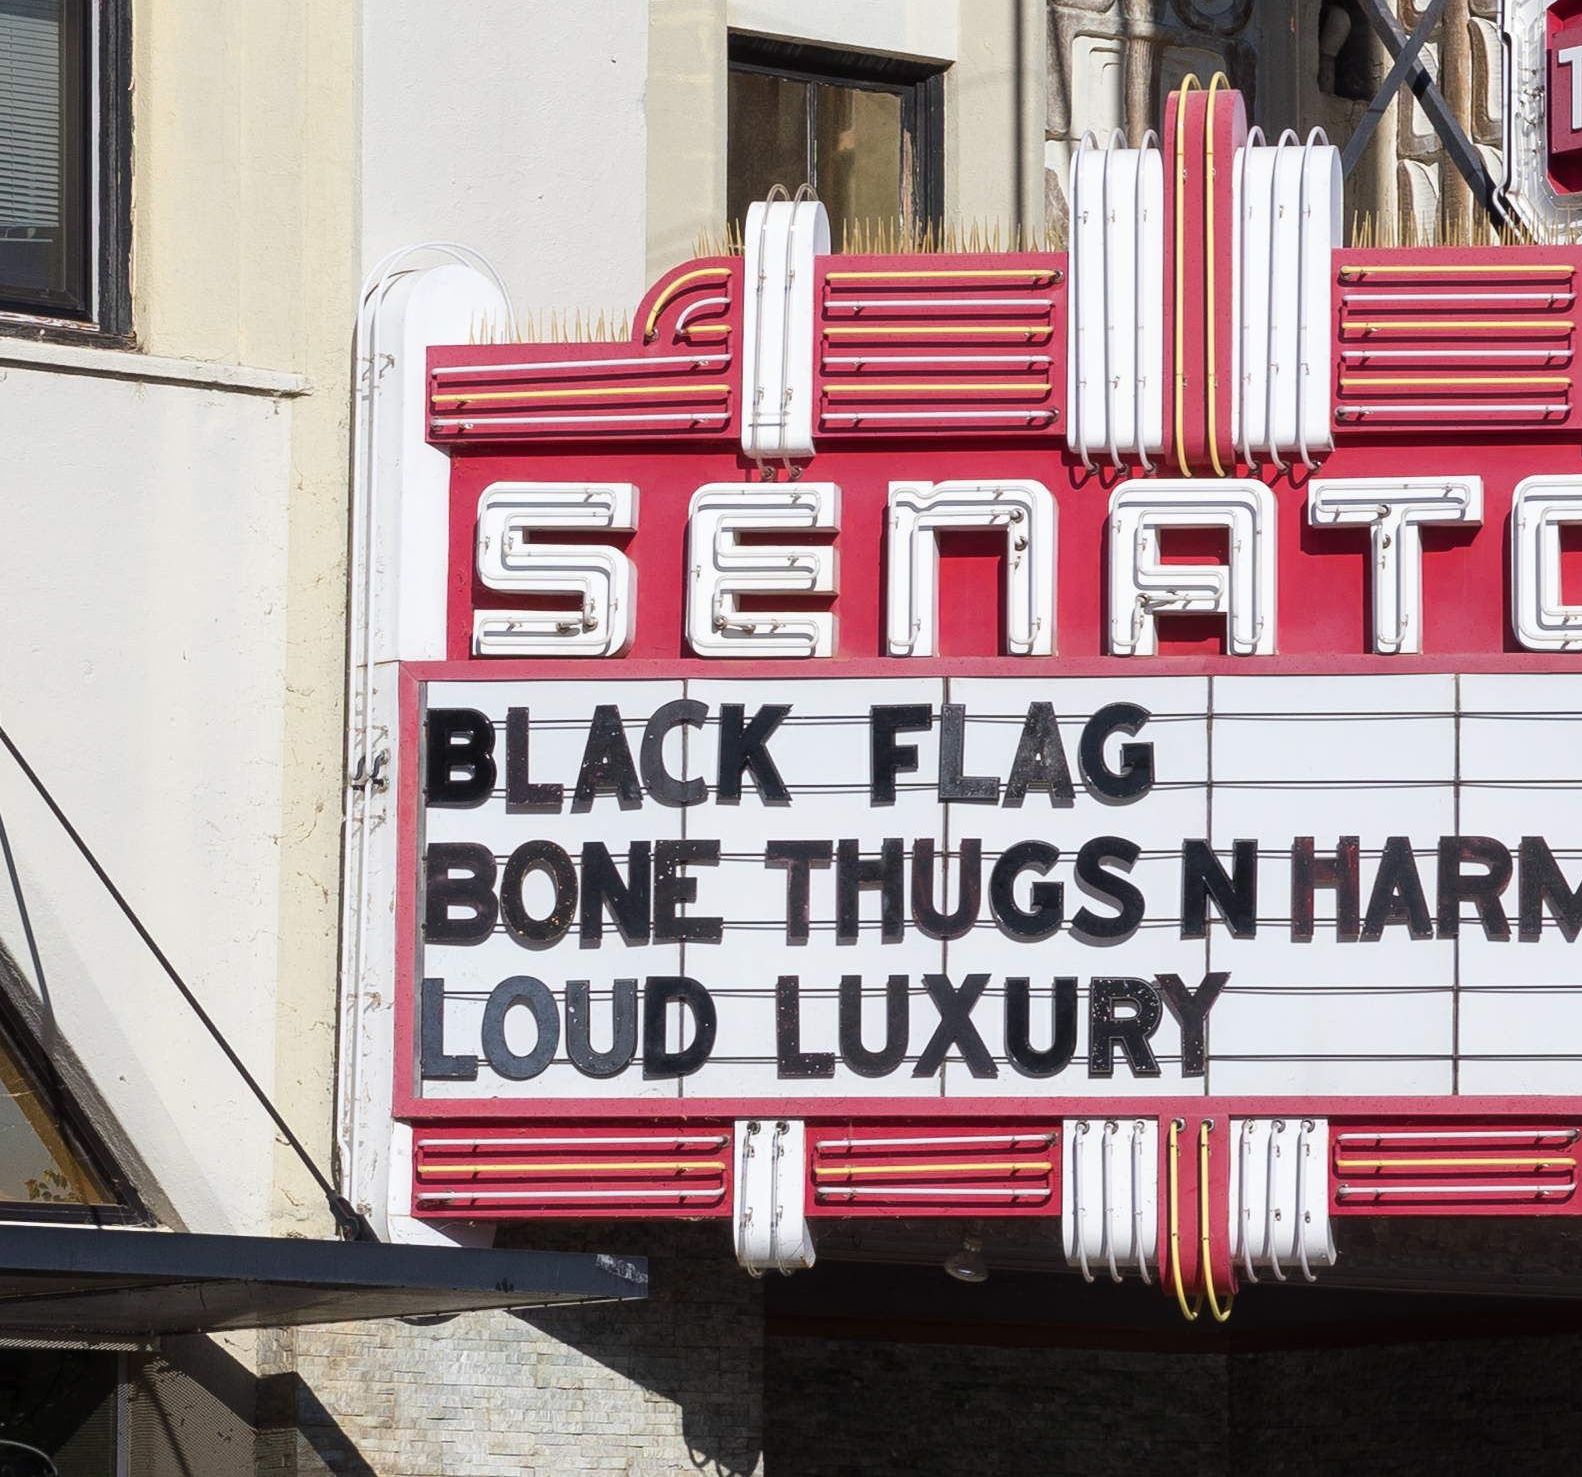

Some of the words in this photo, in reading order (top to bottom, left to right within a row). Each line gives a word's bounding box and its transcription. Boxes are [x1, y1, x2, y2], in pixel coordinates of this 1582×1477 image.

[425, 699, 792, 813] BLACK
[869, 701, 1156, 811] FLAG
[423, 837, 724, 948] BONE
[765, 835, 1146, 948] THUGS
[1180, 838, 1258, 940] N
[420, 974, 718, 1081] LOUD
[776, 971, 1231, 1081] LUXURY
